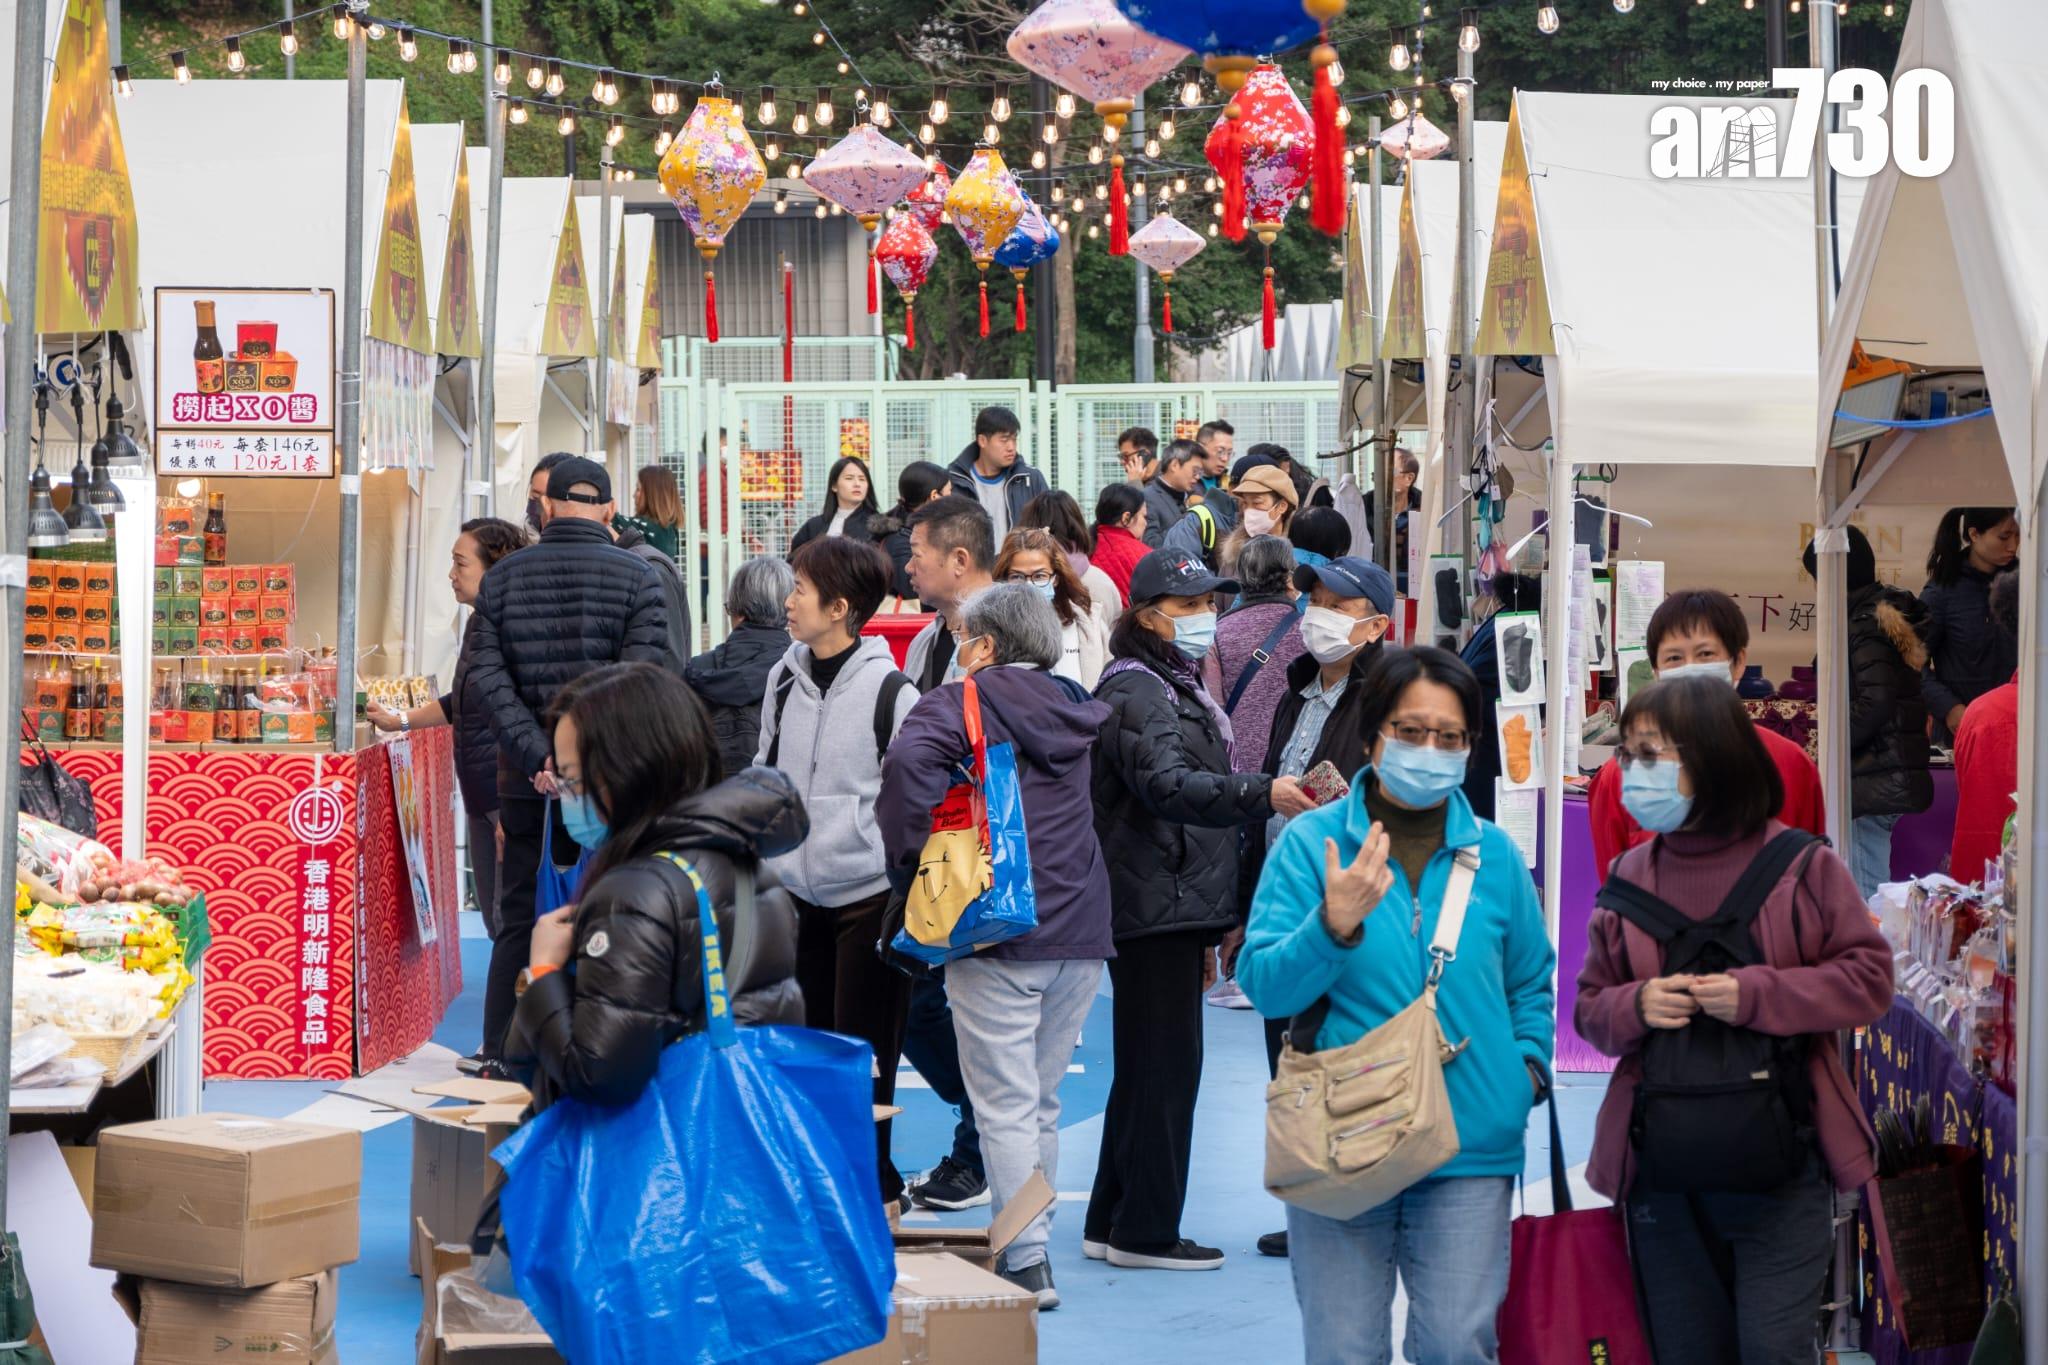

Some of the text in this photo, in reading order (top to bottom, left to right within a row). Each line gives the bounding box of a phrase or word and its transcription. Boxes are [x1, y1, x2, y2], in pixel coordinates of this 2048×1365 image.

[173, 393, 317, 422] 撈起XO醬
[233, 436, 320, 453] 每套146元
[234, 454, 320, 472] 120元1套
[302, 859, 331, 1044] 香港明新隆食品
[704, 934, 728, 1018] IKEA
